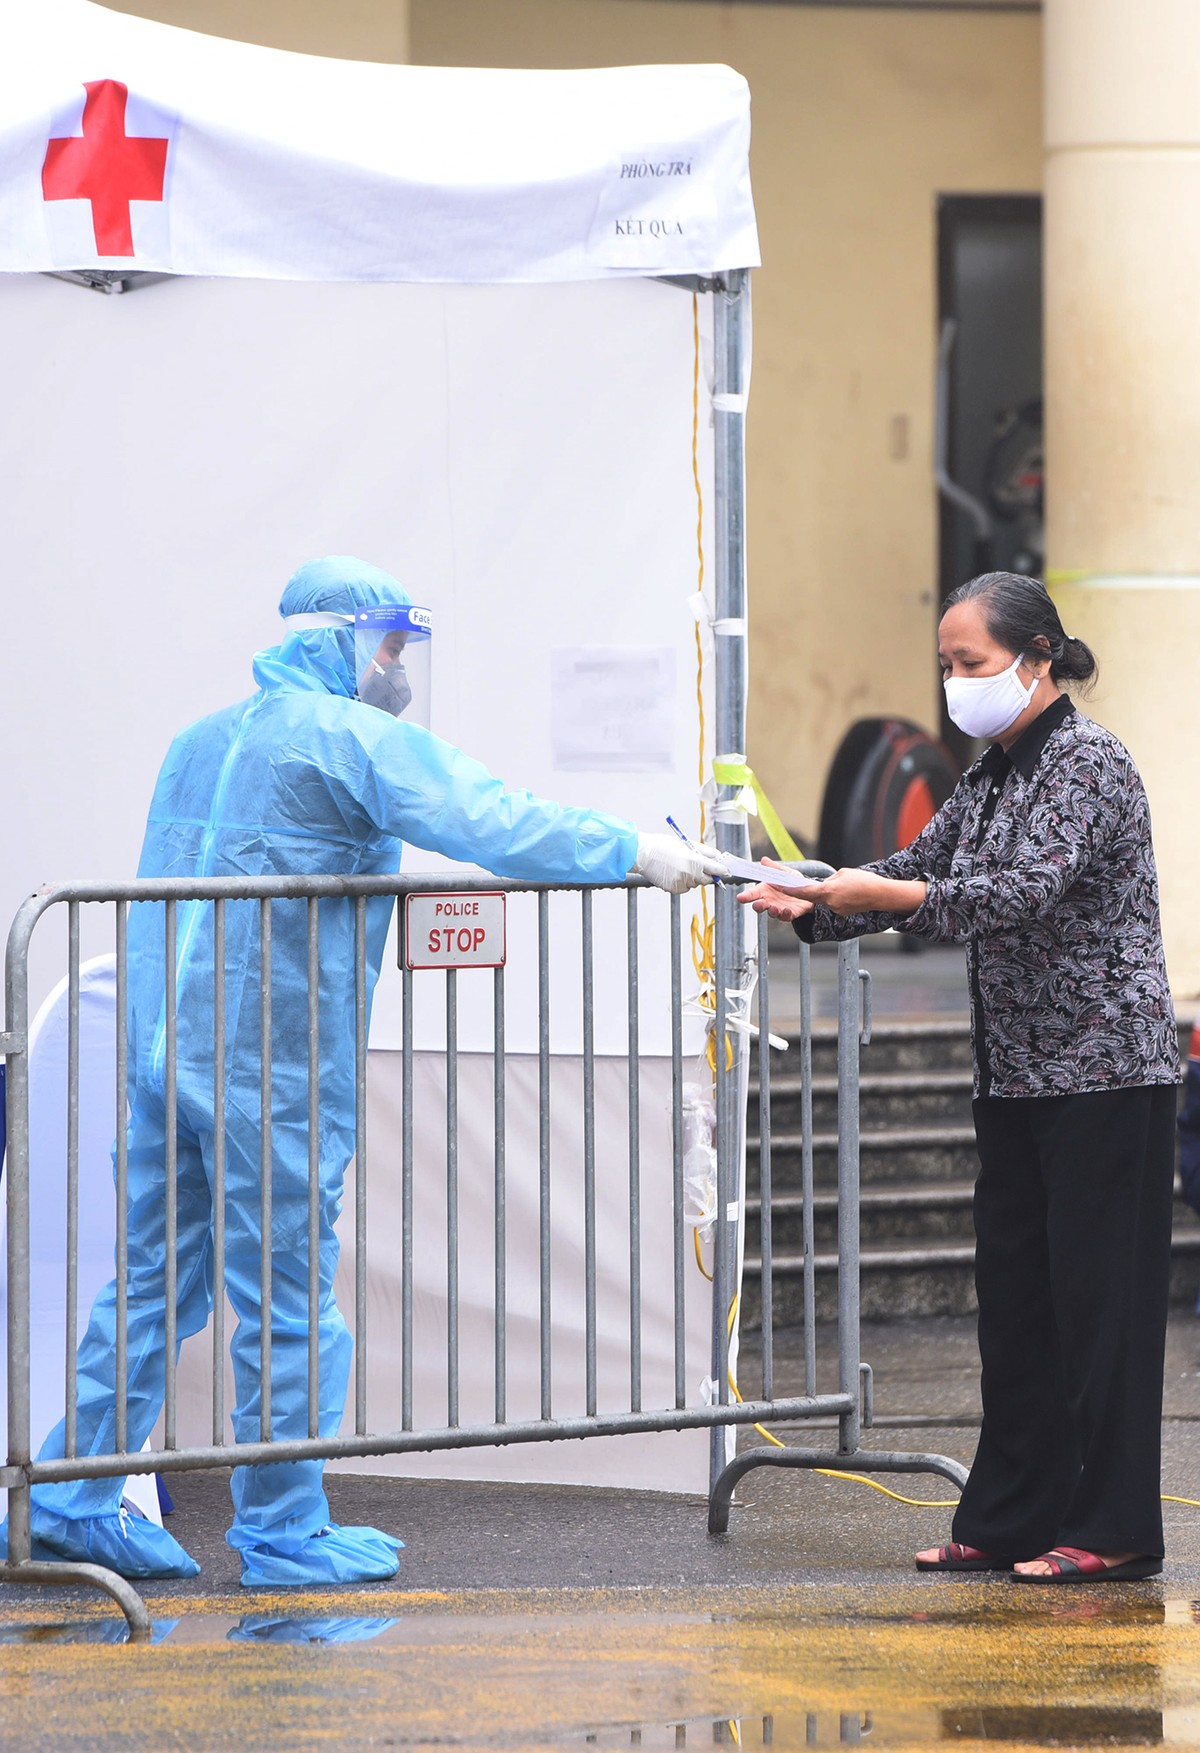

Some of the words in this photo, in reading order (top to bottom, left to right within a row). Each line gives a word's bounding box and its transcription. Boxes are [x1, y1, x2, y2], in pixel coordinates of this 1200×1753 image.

[620, 159, 666, 179] PHÒNG
[413, 611, 430, 625] Face
[435, 902, 479, 916] POLICE
[428, 927, 486, 953] STOP
